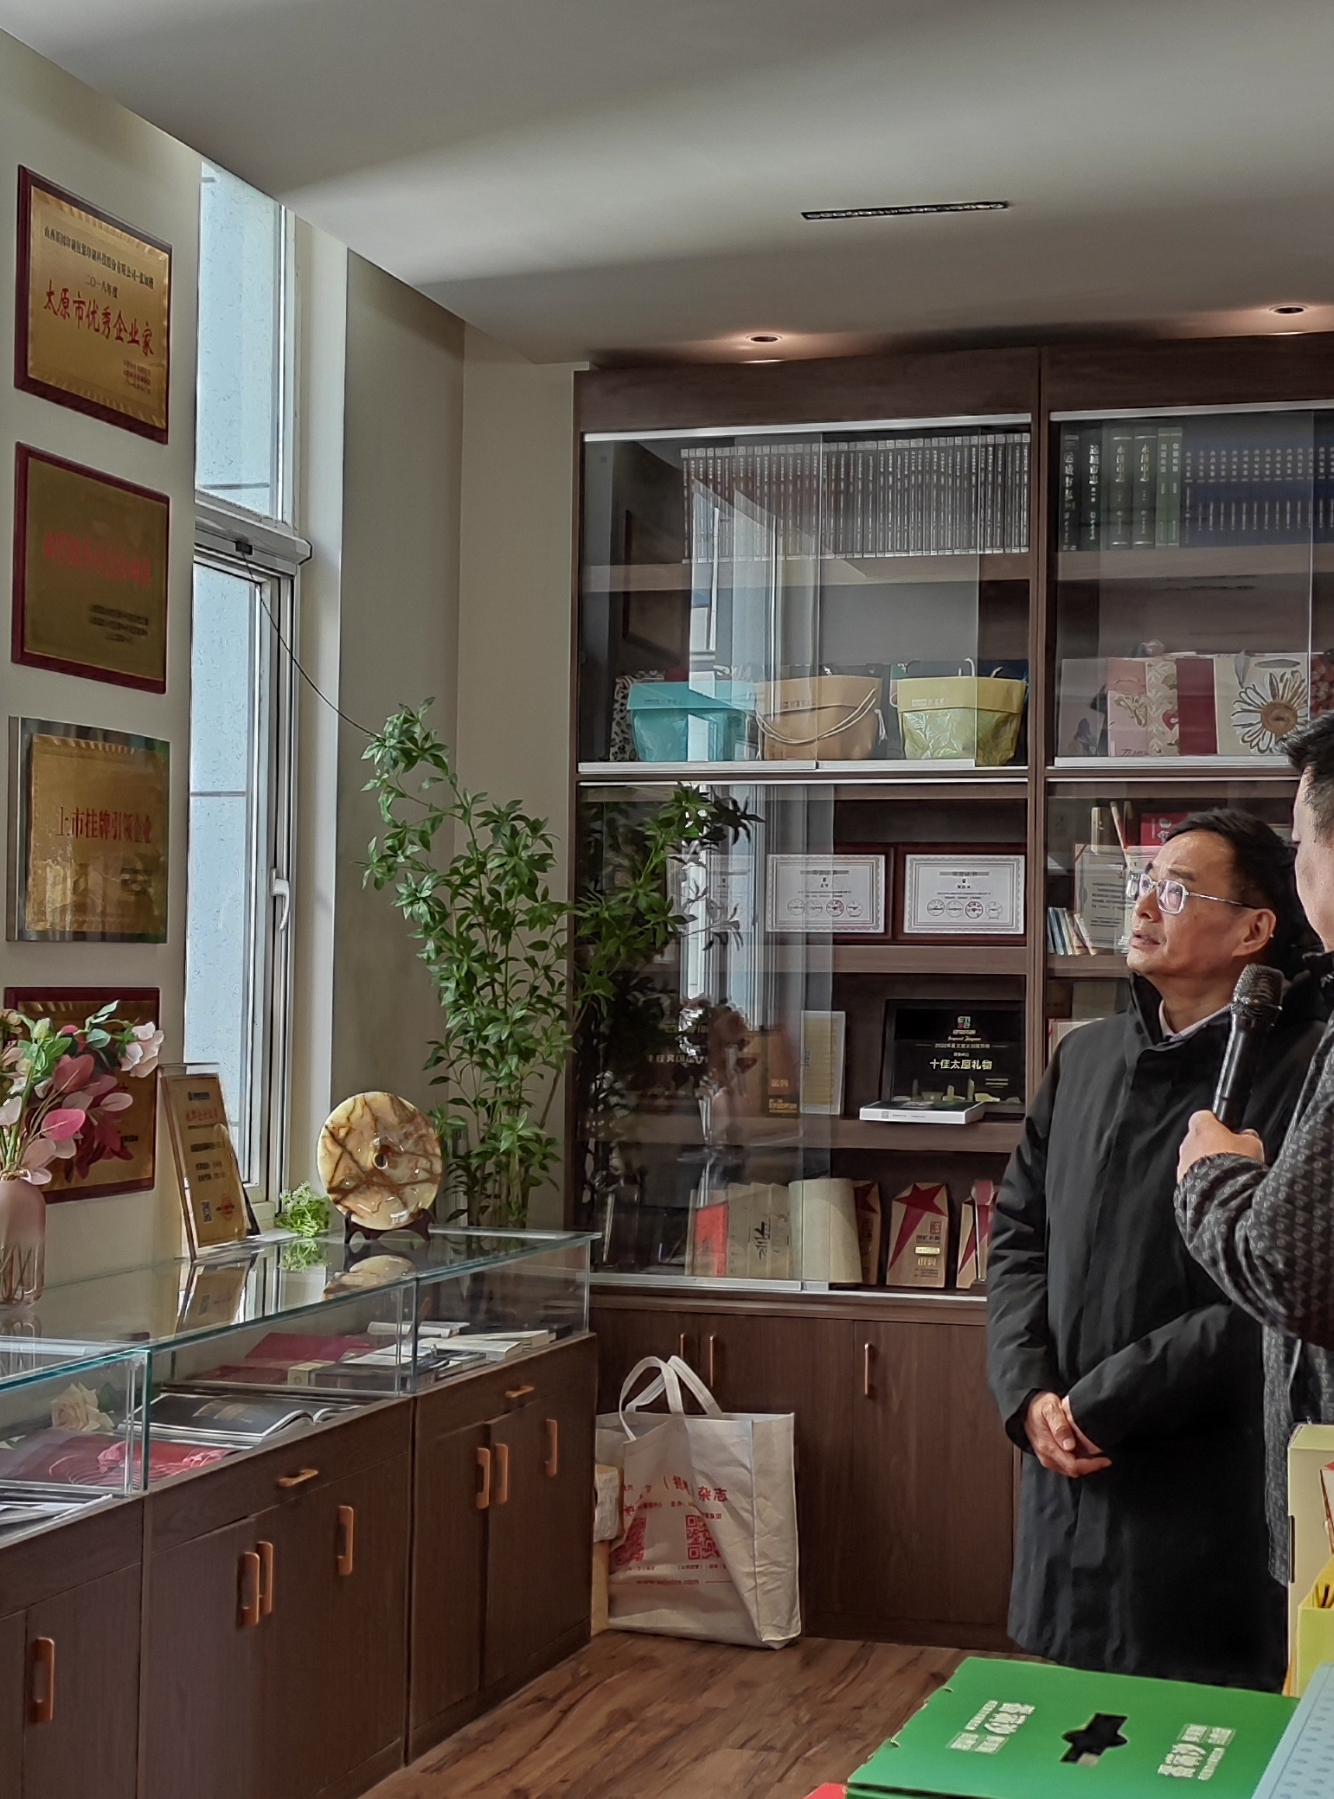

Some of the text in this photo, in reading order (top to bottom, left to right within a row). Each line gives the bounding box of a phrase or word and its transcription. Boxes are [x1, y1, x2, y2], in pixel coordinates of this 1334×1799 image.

[43, 279, 155, 357] 太原市优秀企业家
[929, 1058, 993, 1071] 十佳太原礼物
